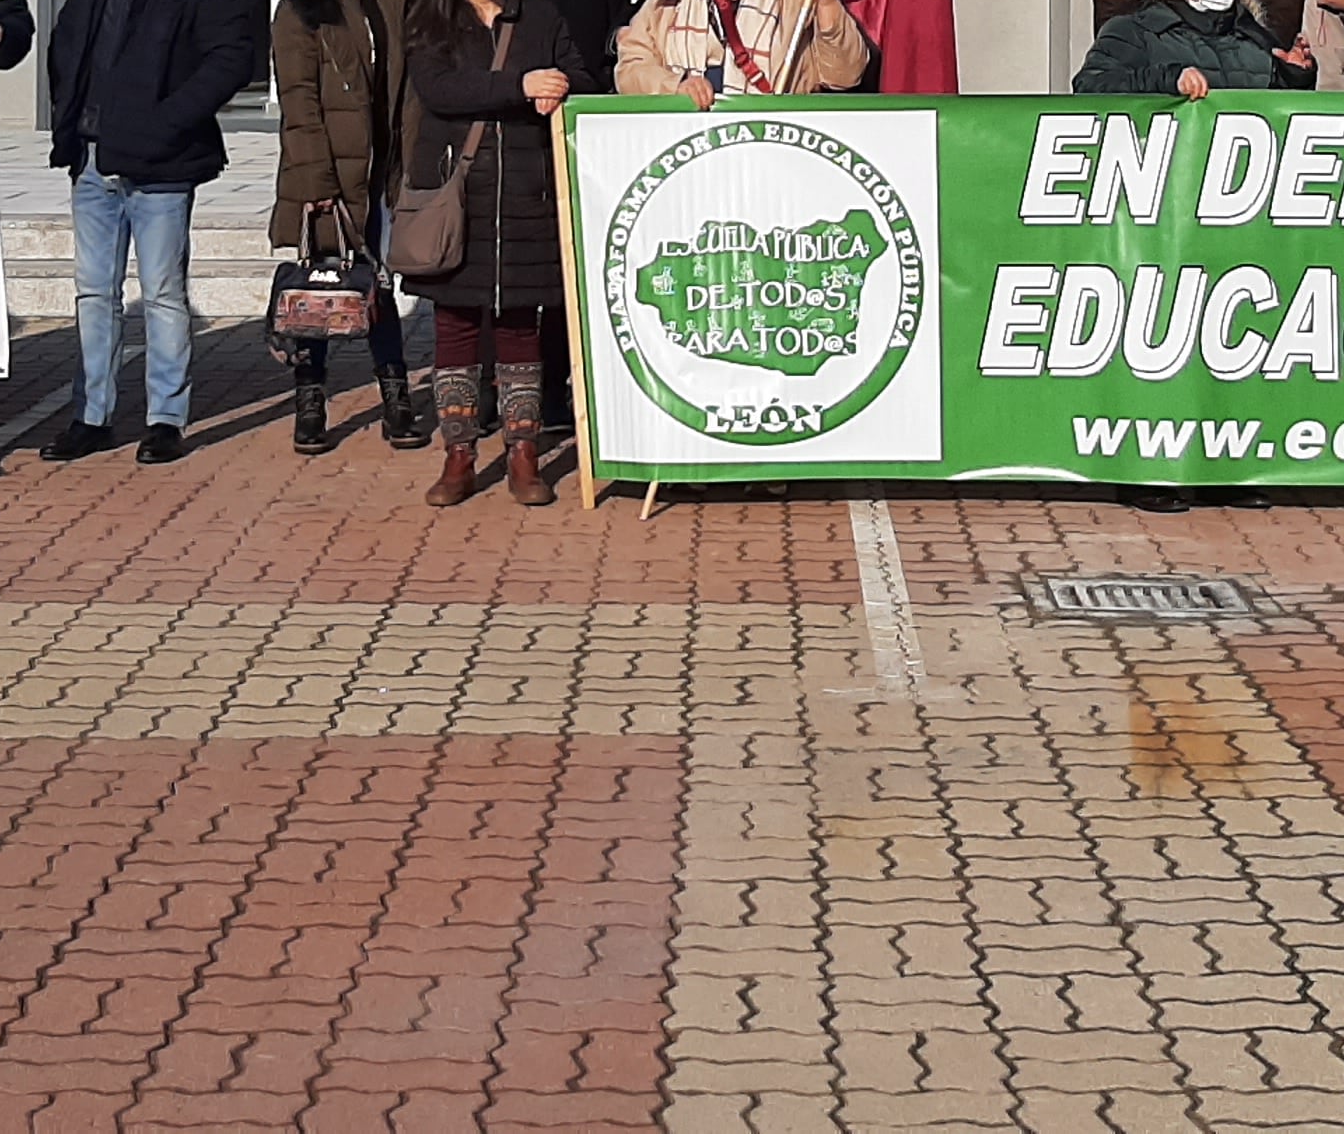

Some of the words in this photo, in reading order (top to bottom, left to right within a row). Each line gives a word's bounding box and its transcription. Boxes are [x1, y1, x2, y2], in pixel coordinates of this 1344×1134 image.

[1018, 112, 1179, 225] EN
[606, 169, 664, 354] PLATAFORMA
[659, 130, 714, 174] POR
[717, 123, 756, 147] LA
[763, 123, 906, 220] EDUCACIÓN
[889, 227, 923, 349] PÚBLICA
[686, 284, 734, 311] DE
[738, 280, 847, 312] TOD@S
[704, 399, 824, 434] LEÓN
